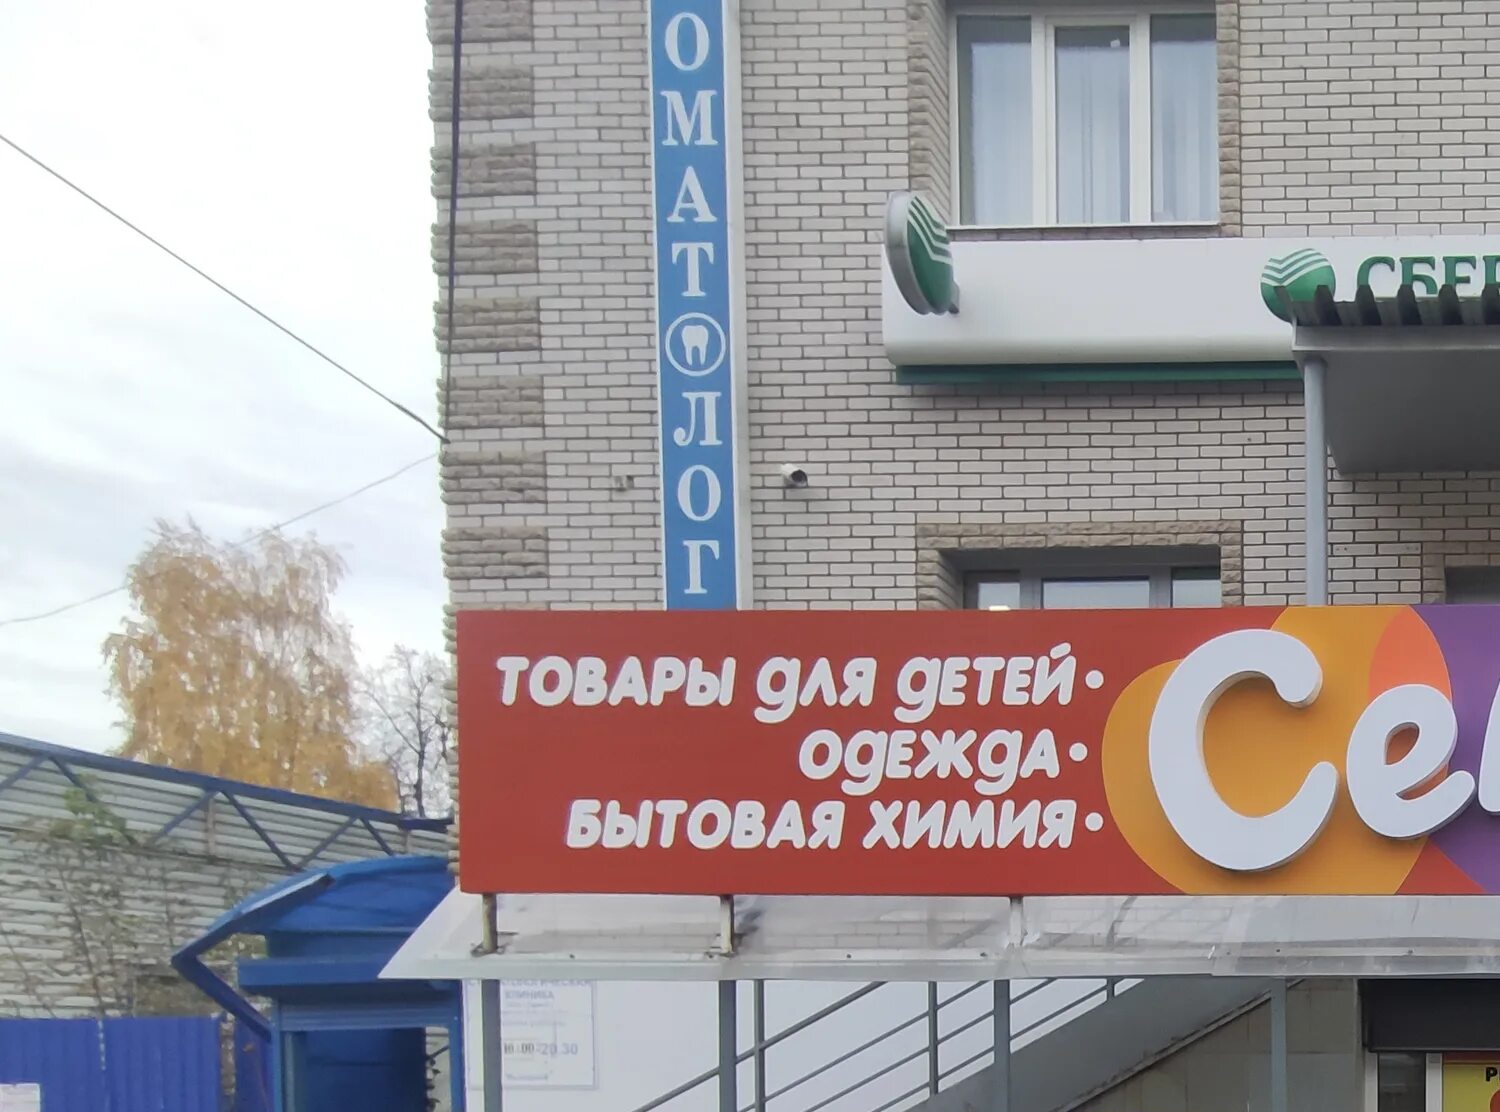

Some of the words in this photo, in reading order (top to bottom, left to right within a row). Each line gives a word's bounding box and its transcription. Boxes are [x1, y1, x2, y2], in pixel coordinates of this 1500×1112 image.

[497, 655, 737, 706] ТОВАРЫ
[566, 800, 846, 850] БЫТОВАЯ
[862, 800, 1078, 850] ХИМИЯ
